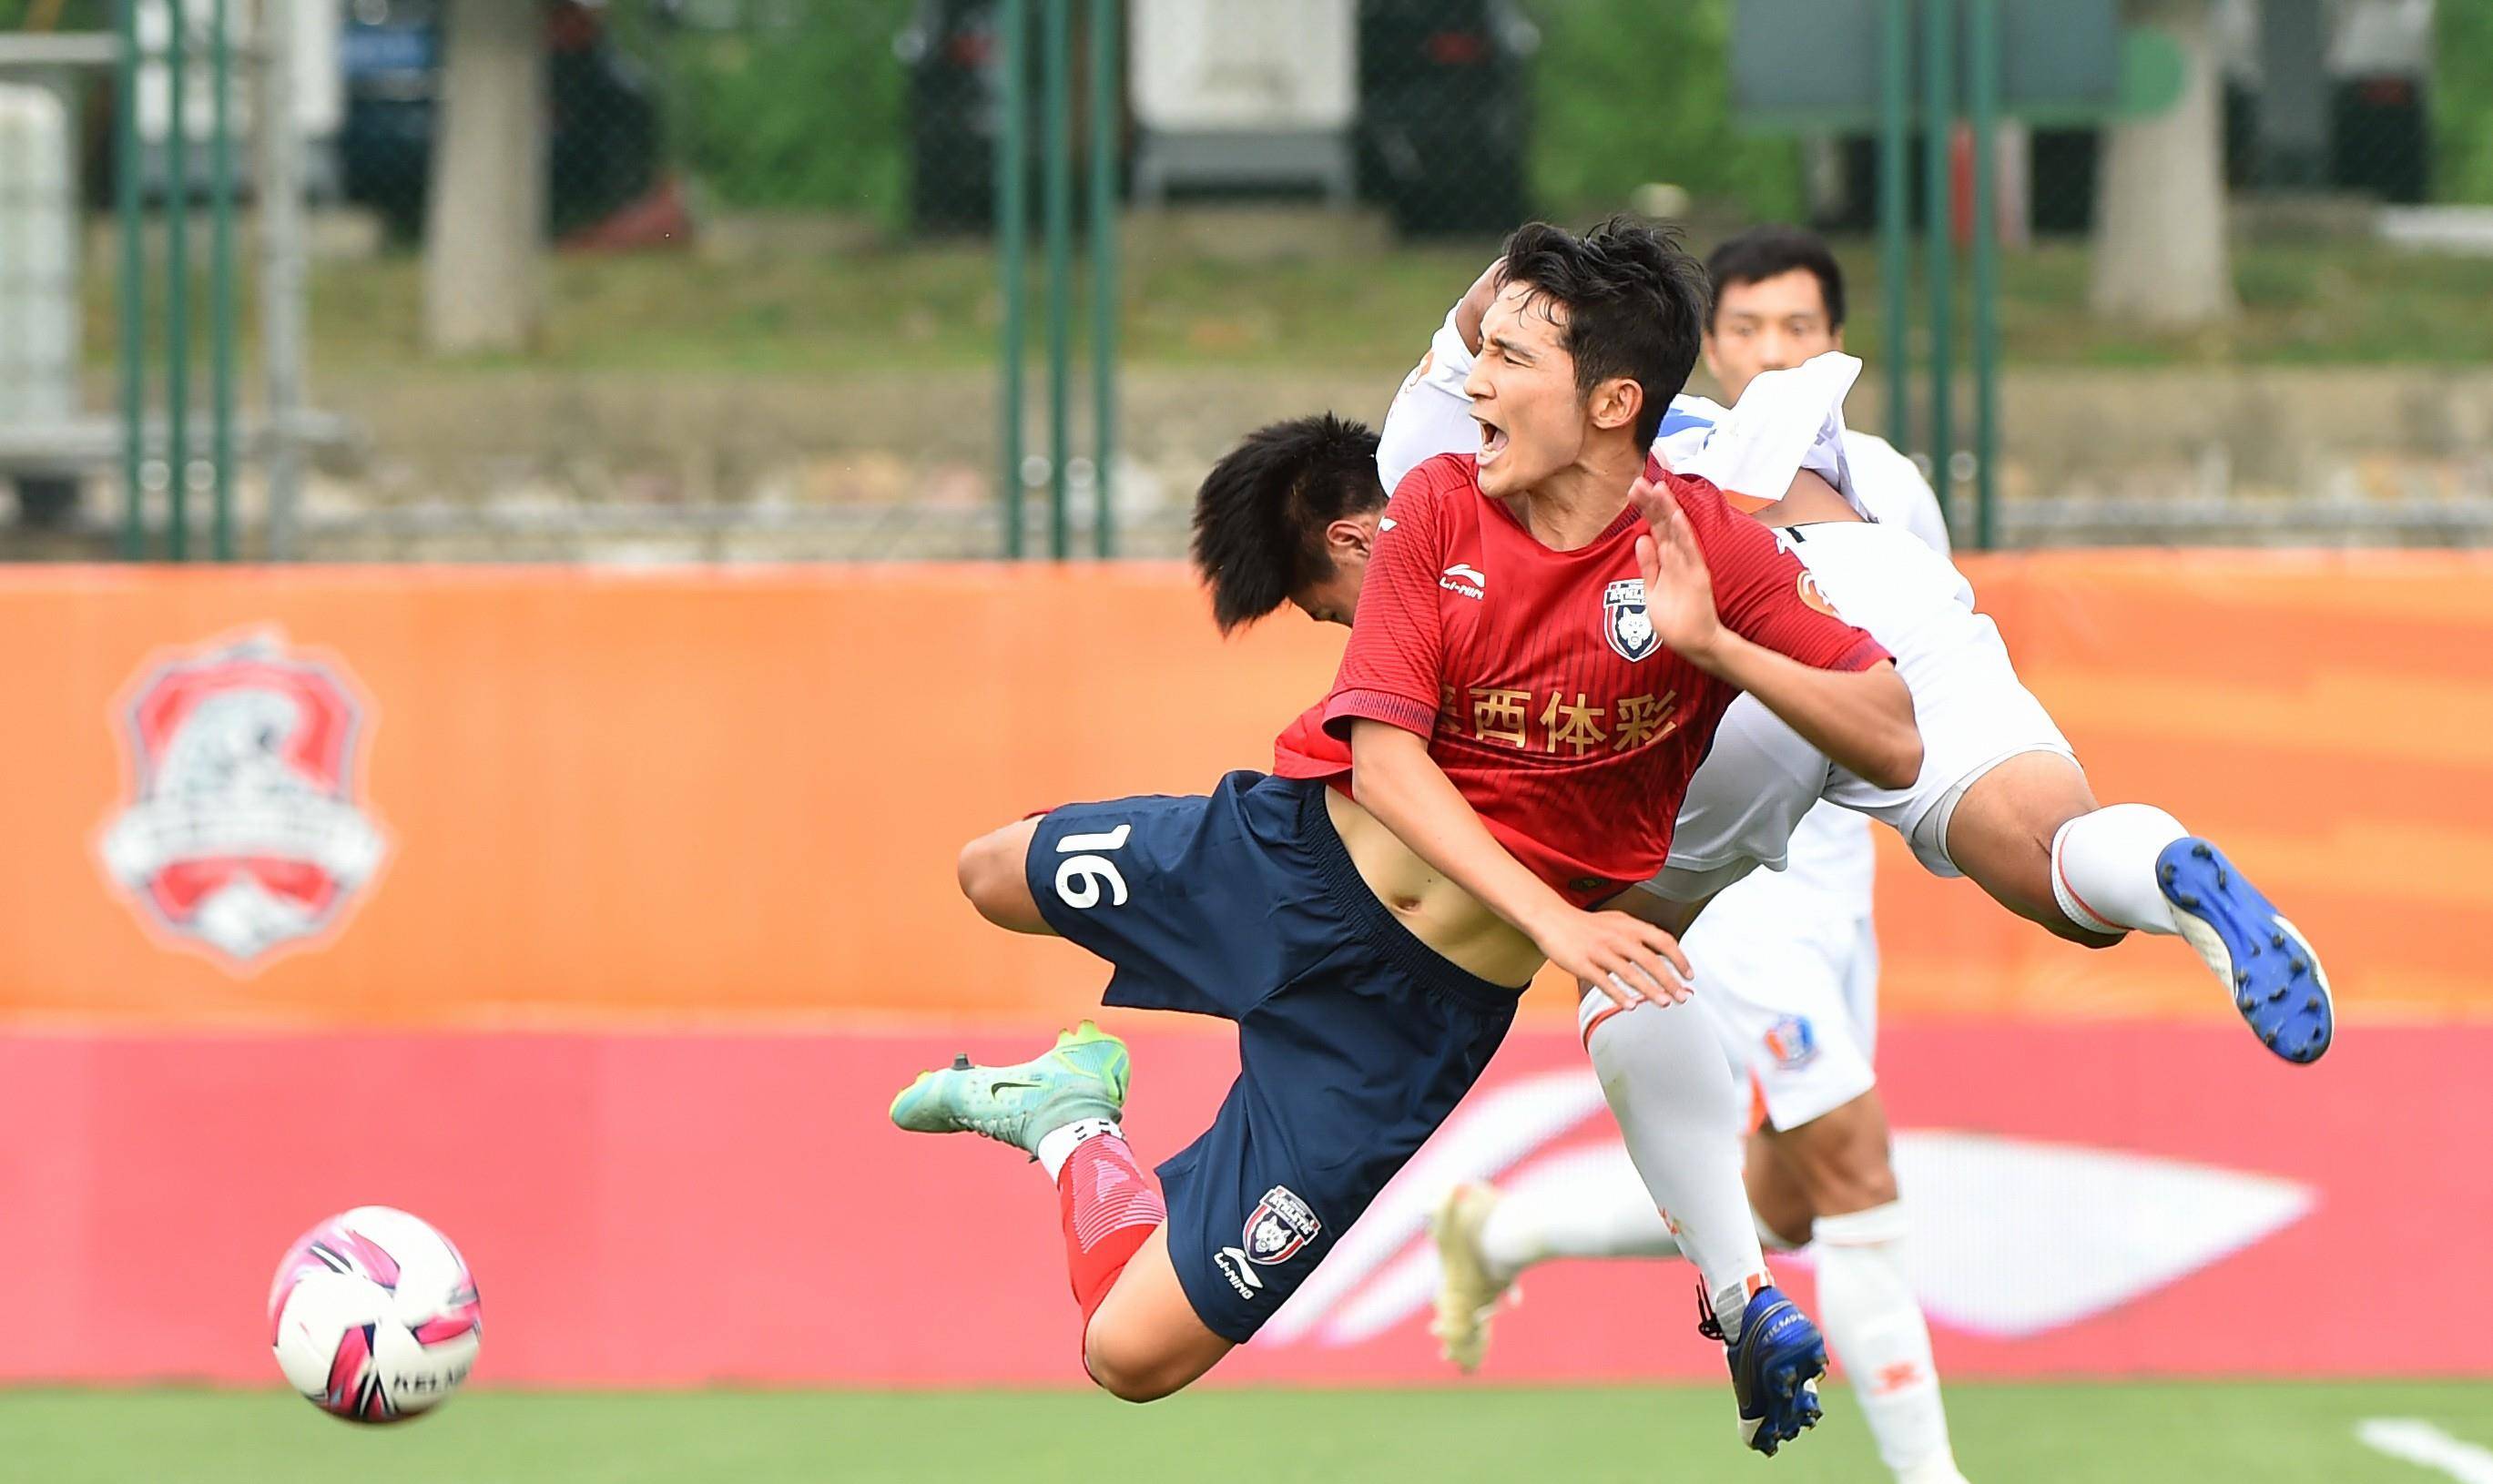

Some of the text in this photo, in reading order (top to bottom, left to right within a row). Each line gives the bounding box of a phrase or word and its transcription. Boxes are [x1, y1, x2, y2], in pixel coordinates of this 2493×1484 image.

[1440, 576, 1484, 600] LI-NIN
[1055, 824, 1132, 909] 16
[1213, 1252, 1255, 1300] LI-NING
